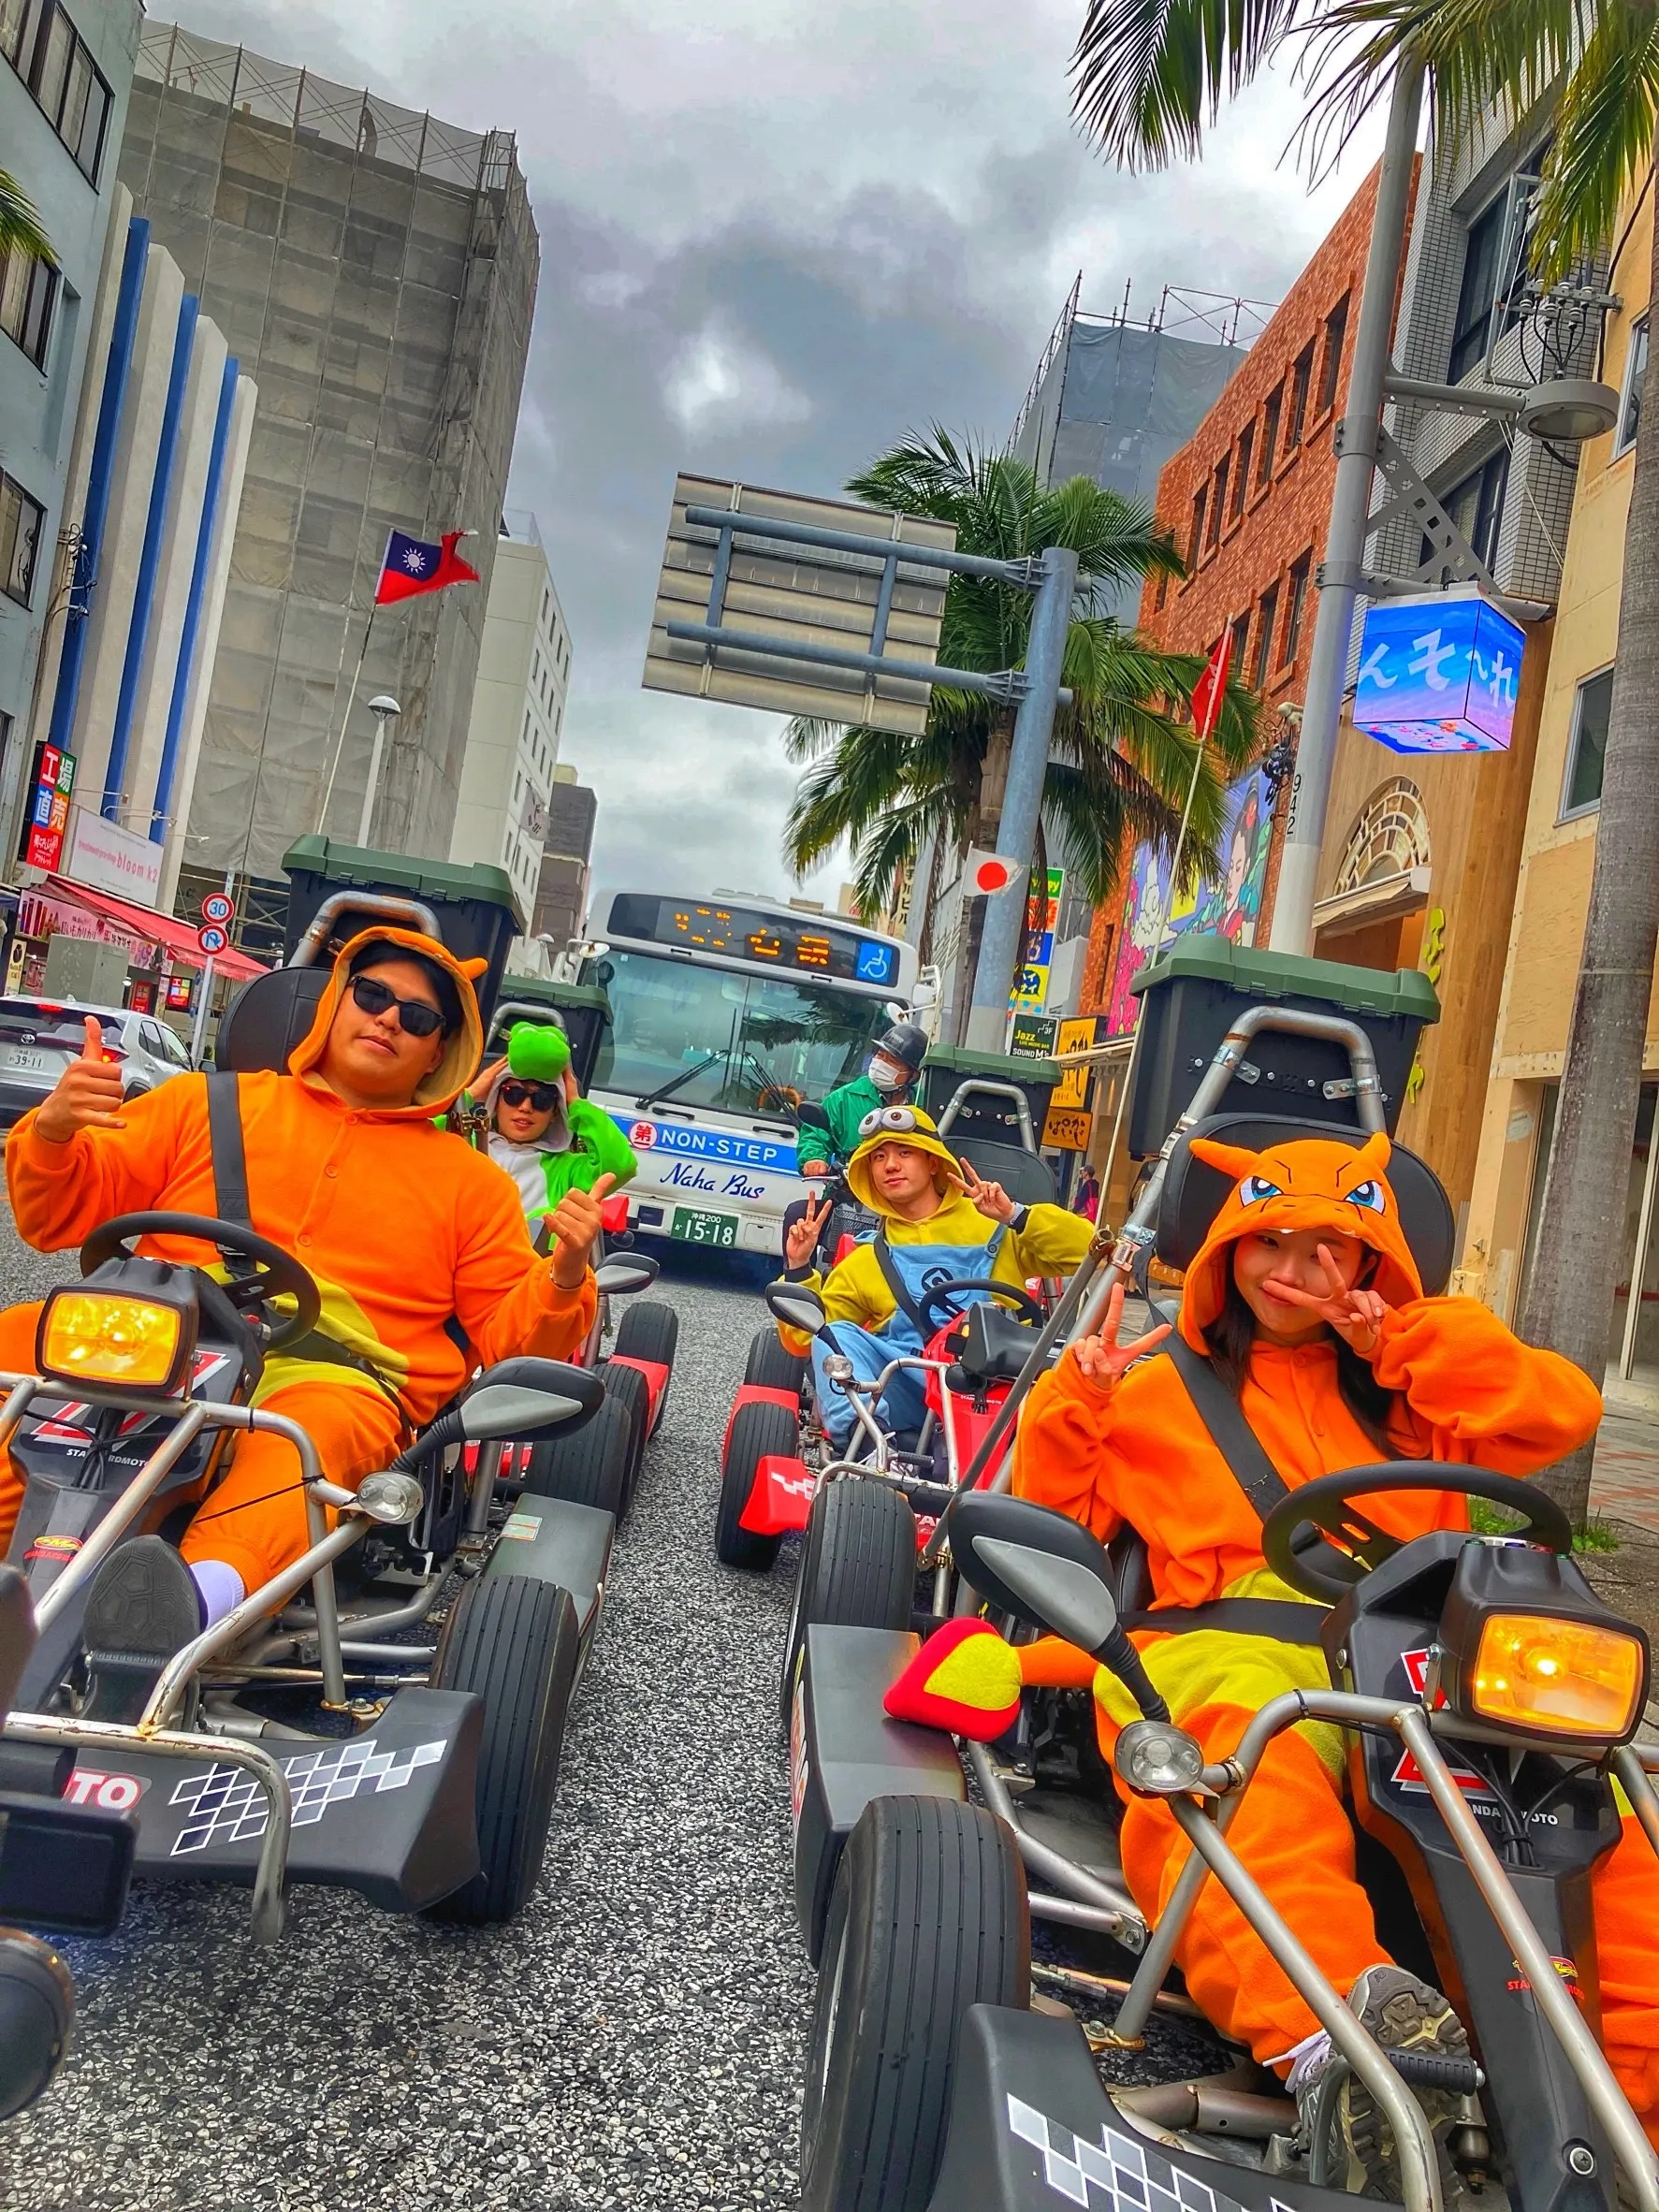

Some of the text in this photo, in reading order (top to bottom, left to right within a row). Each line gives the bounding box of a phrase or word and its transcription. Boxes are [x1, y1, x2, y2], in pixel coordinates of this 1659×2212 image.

[42, 750, 74, 793] 工場
[35, 790, 67, 829] 直売
[1287, 773, 1302, 835] 942
[117, 851, 144, 878] bloom
[147, 866, 158, 884] k2
[209, 901, 227, 917] 30
[1014, 1030, 1036, 1041] Jazz
[1043, 1026, 1054, 1035] 3F
[1012, 1048, 1036, 1058] SOUND
[662, 1128, 778, 1162] NON-STEP
[660, 1162, 764, 1200] Naha Bus
[685, 1219, 734, 1245] 15-18
